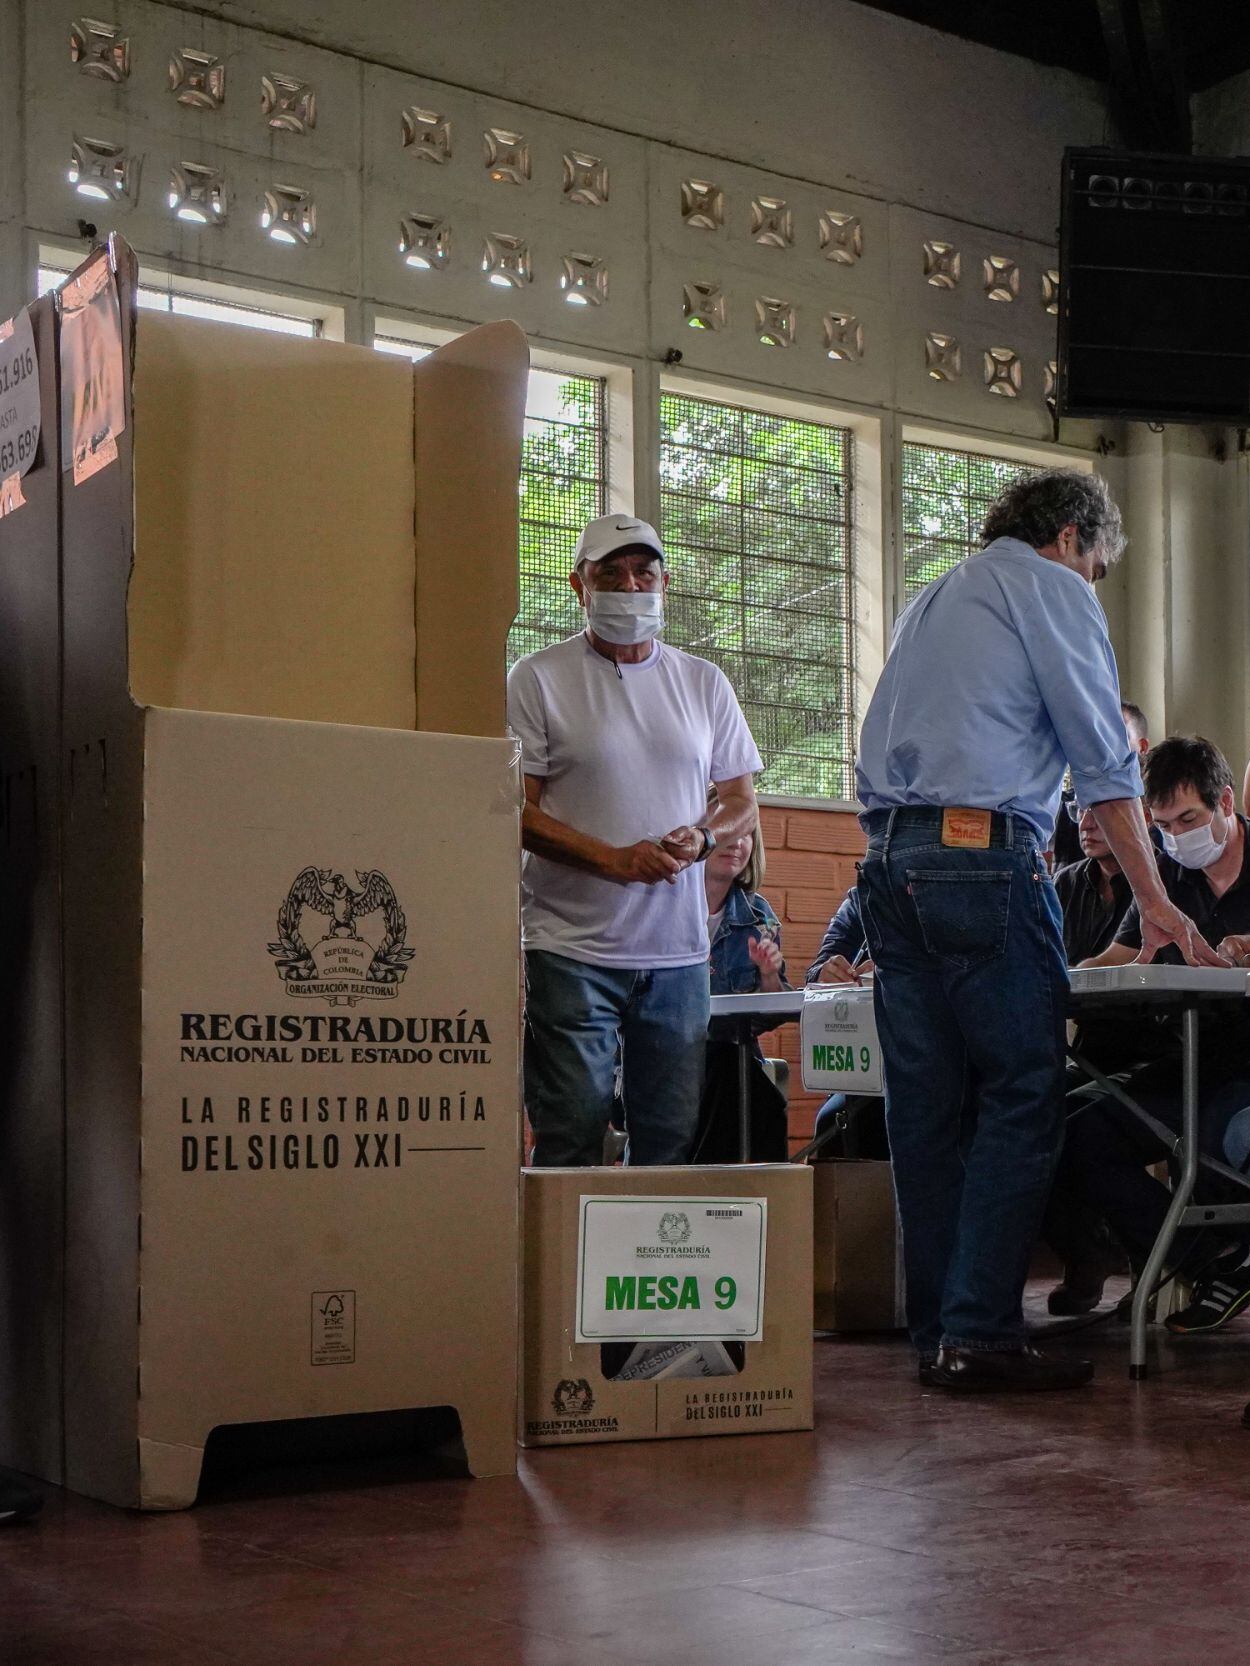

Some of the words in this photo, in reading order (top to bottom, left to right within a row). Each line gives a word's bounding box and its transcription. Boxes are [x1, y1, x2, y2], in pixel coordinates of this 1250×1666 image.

[323, 968, 364, 977] COLOMBIA
[289, 981, 349, 995] ORGANIZACIÓN
[351, 984, 396, 996] ELECTORAL
[180, 1009, 492, 1044] REGISTRADURÍA
[180, 1046, 293, 1063] NACIONAL
[301, 1047, 344, 1063] DEL
[351, 1048, 433, 1064] ESTADO
[438, 1049, 492, 1064] CIVIL
[813, 1045, 855, 1071] MESA
[860, 1046, 871, 1072] 9
[182, 1097, 214, 1123] LA
[238, 1091, 486, 1122] REGISTRADURÍA
[182, 1135, 239, 1171] DEL
[248, 1133, 340, 1170] SIGLO
[354, 1133, 401, 1168] XXI
[636, 1244, 711, 1254] REGISTRADURÍA
[605, 1276, 701, 1310] MESA
[714, 1276, 737, 1310] 9
[686, 1394, 698, 1404] LA
[704, 1387, 794, 1403] REGISTRADURÍA
[708, 1405, 741, 1419] SIGLO
[745, 1404, 763, 1417] XXI
[528, 1416, 619, 1431] REGISTRADURÍA
